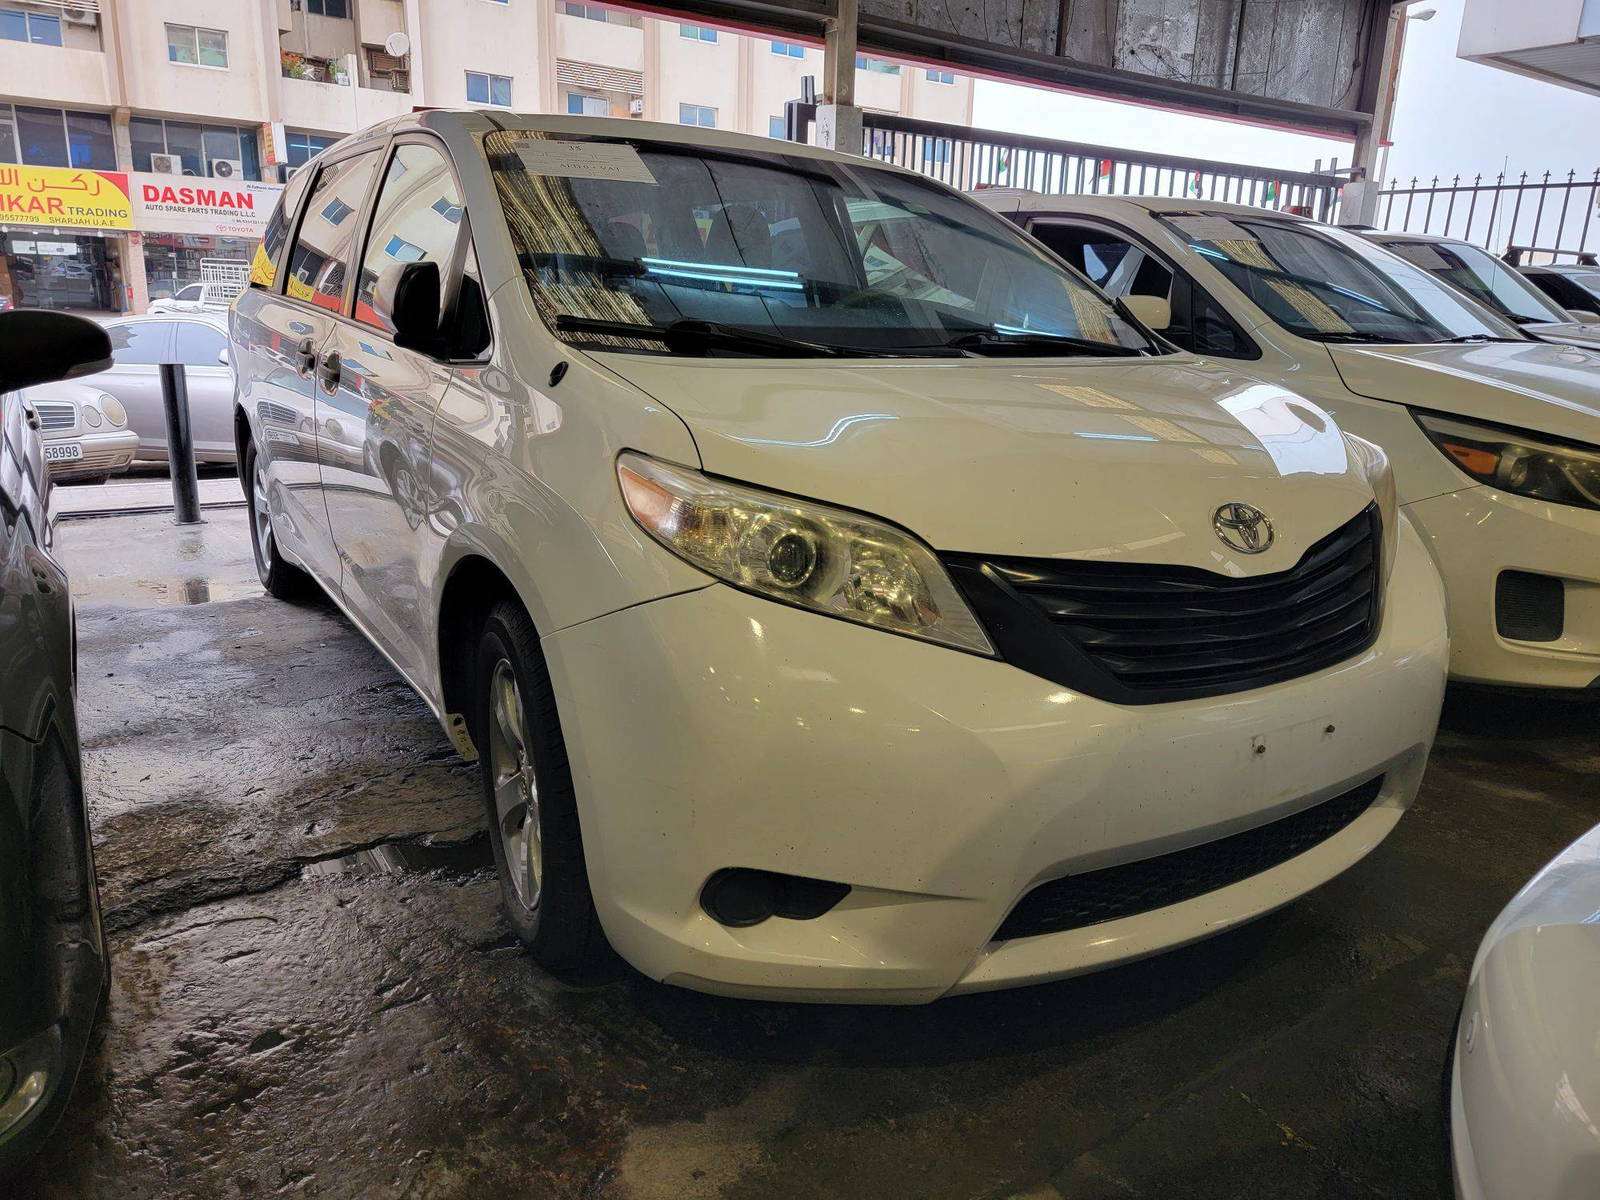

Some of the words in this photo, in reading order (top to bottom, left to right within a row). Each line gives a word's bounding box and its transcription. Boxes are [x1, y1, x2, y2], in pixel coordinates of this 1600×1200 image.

[27, 173, 101, 196] ركن
[143, 184, 254, 210] DASMAN
[67, 206, 128, 219] TRADING
[165, 205, 185, 213] SPARE
[210, 209, 239, 217] TRADING
[49, 216, 91, 225] SHARJAH
[45, 446, 79, 459] 58998
